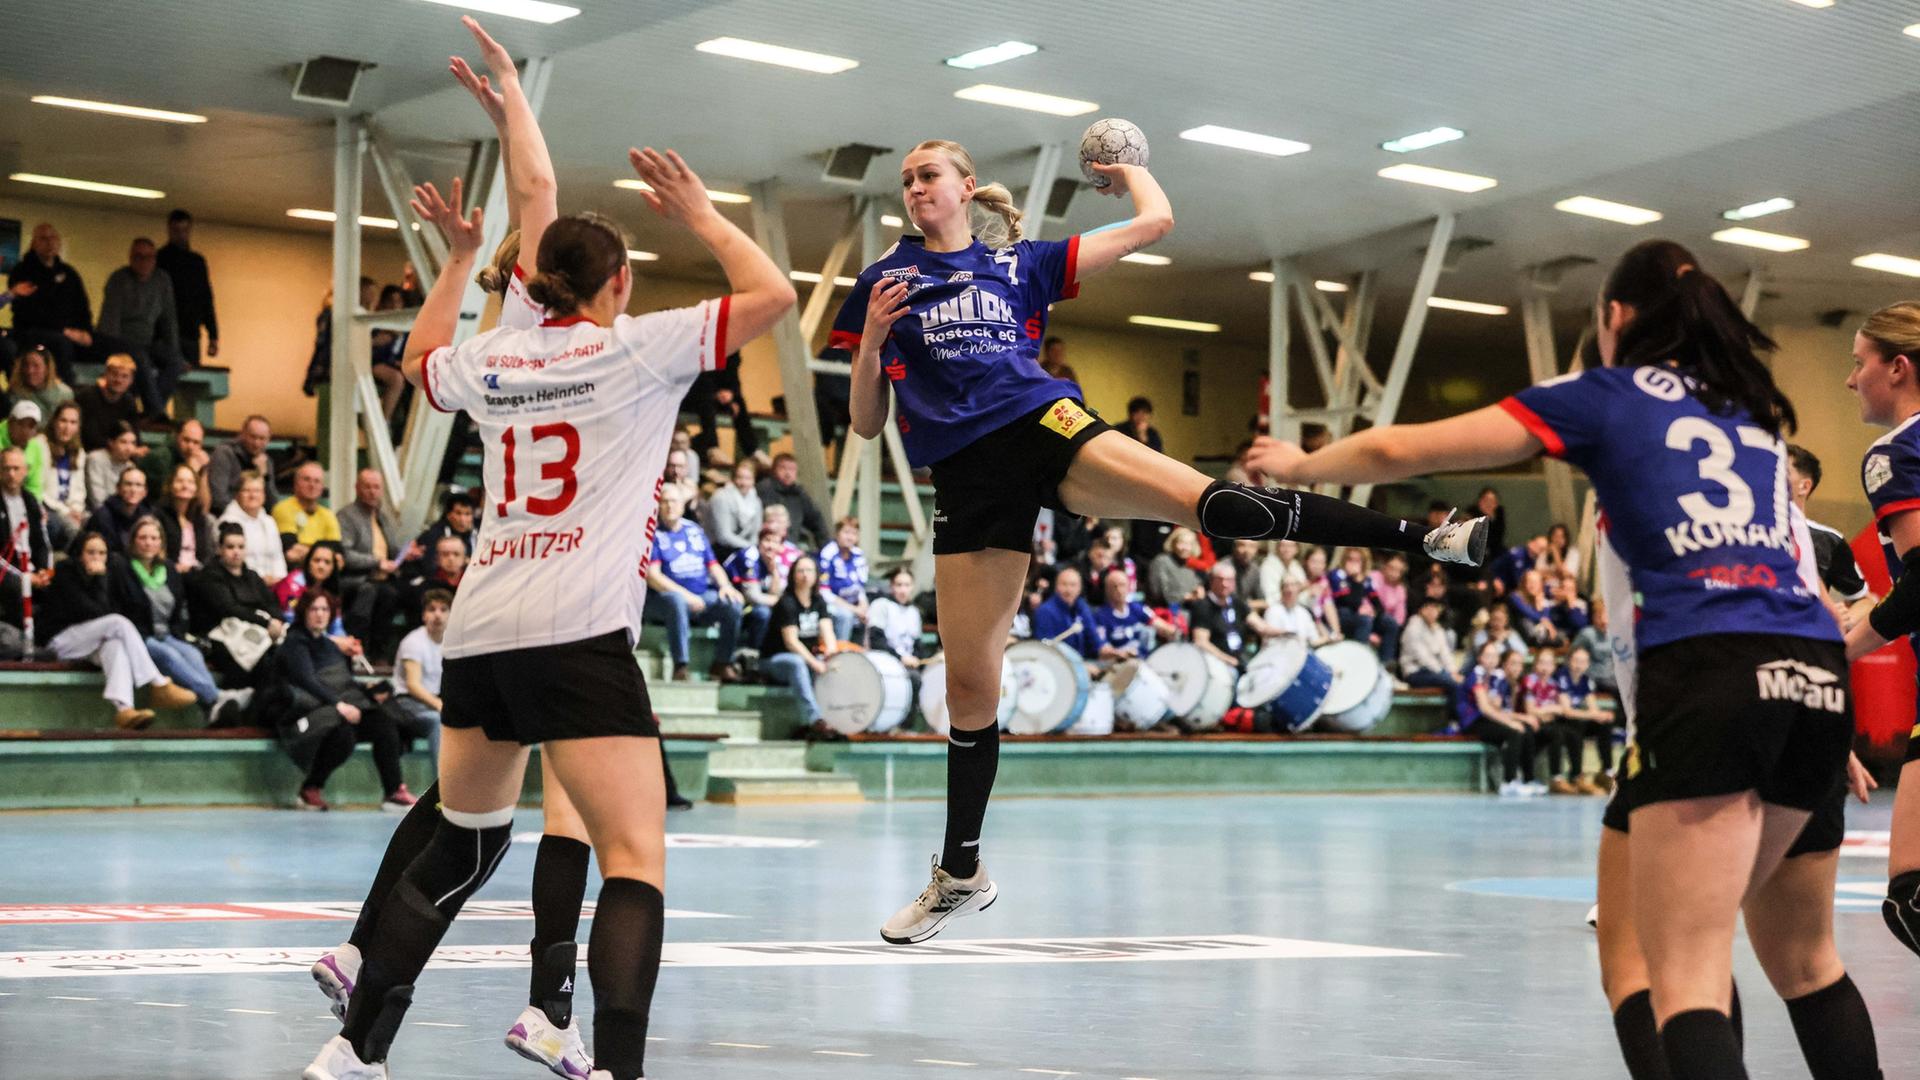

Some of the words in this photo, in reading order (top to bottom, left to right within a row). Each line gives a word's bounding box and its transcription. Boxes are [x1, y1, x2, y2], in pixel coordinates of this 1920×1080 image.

[993, 254, 1018, 285] 7
[924, 327, 992, 345] Rostock
[998, 330, 1017, 342] eG
[536, 382, 595, 402] Heinrich
[496, 421, 581, 517] 13
[1665, 416, 1790, 542] 37
